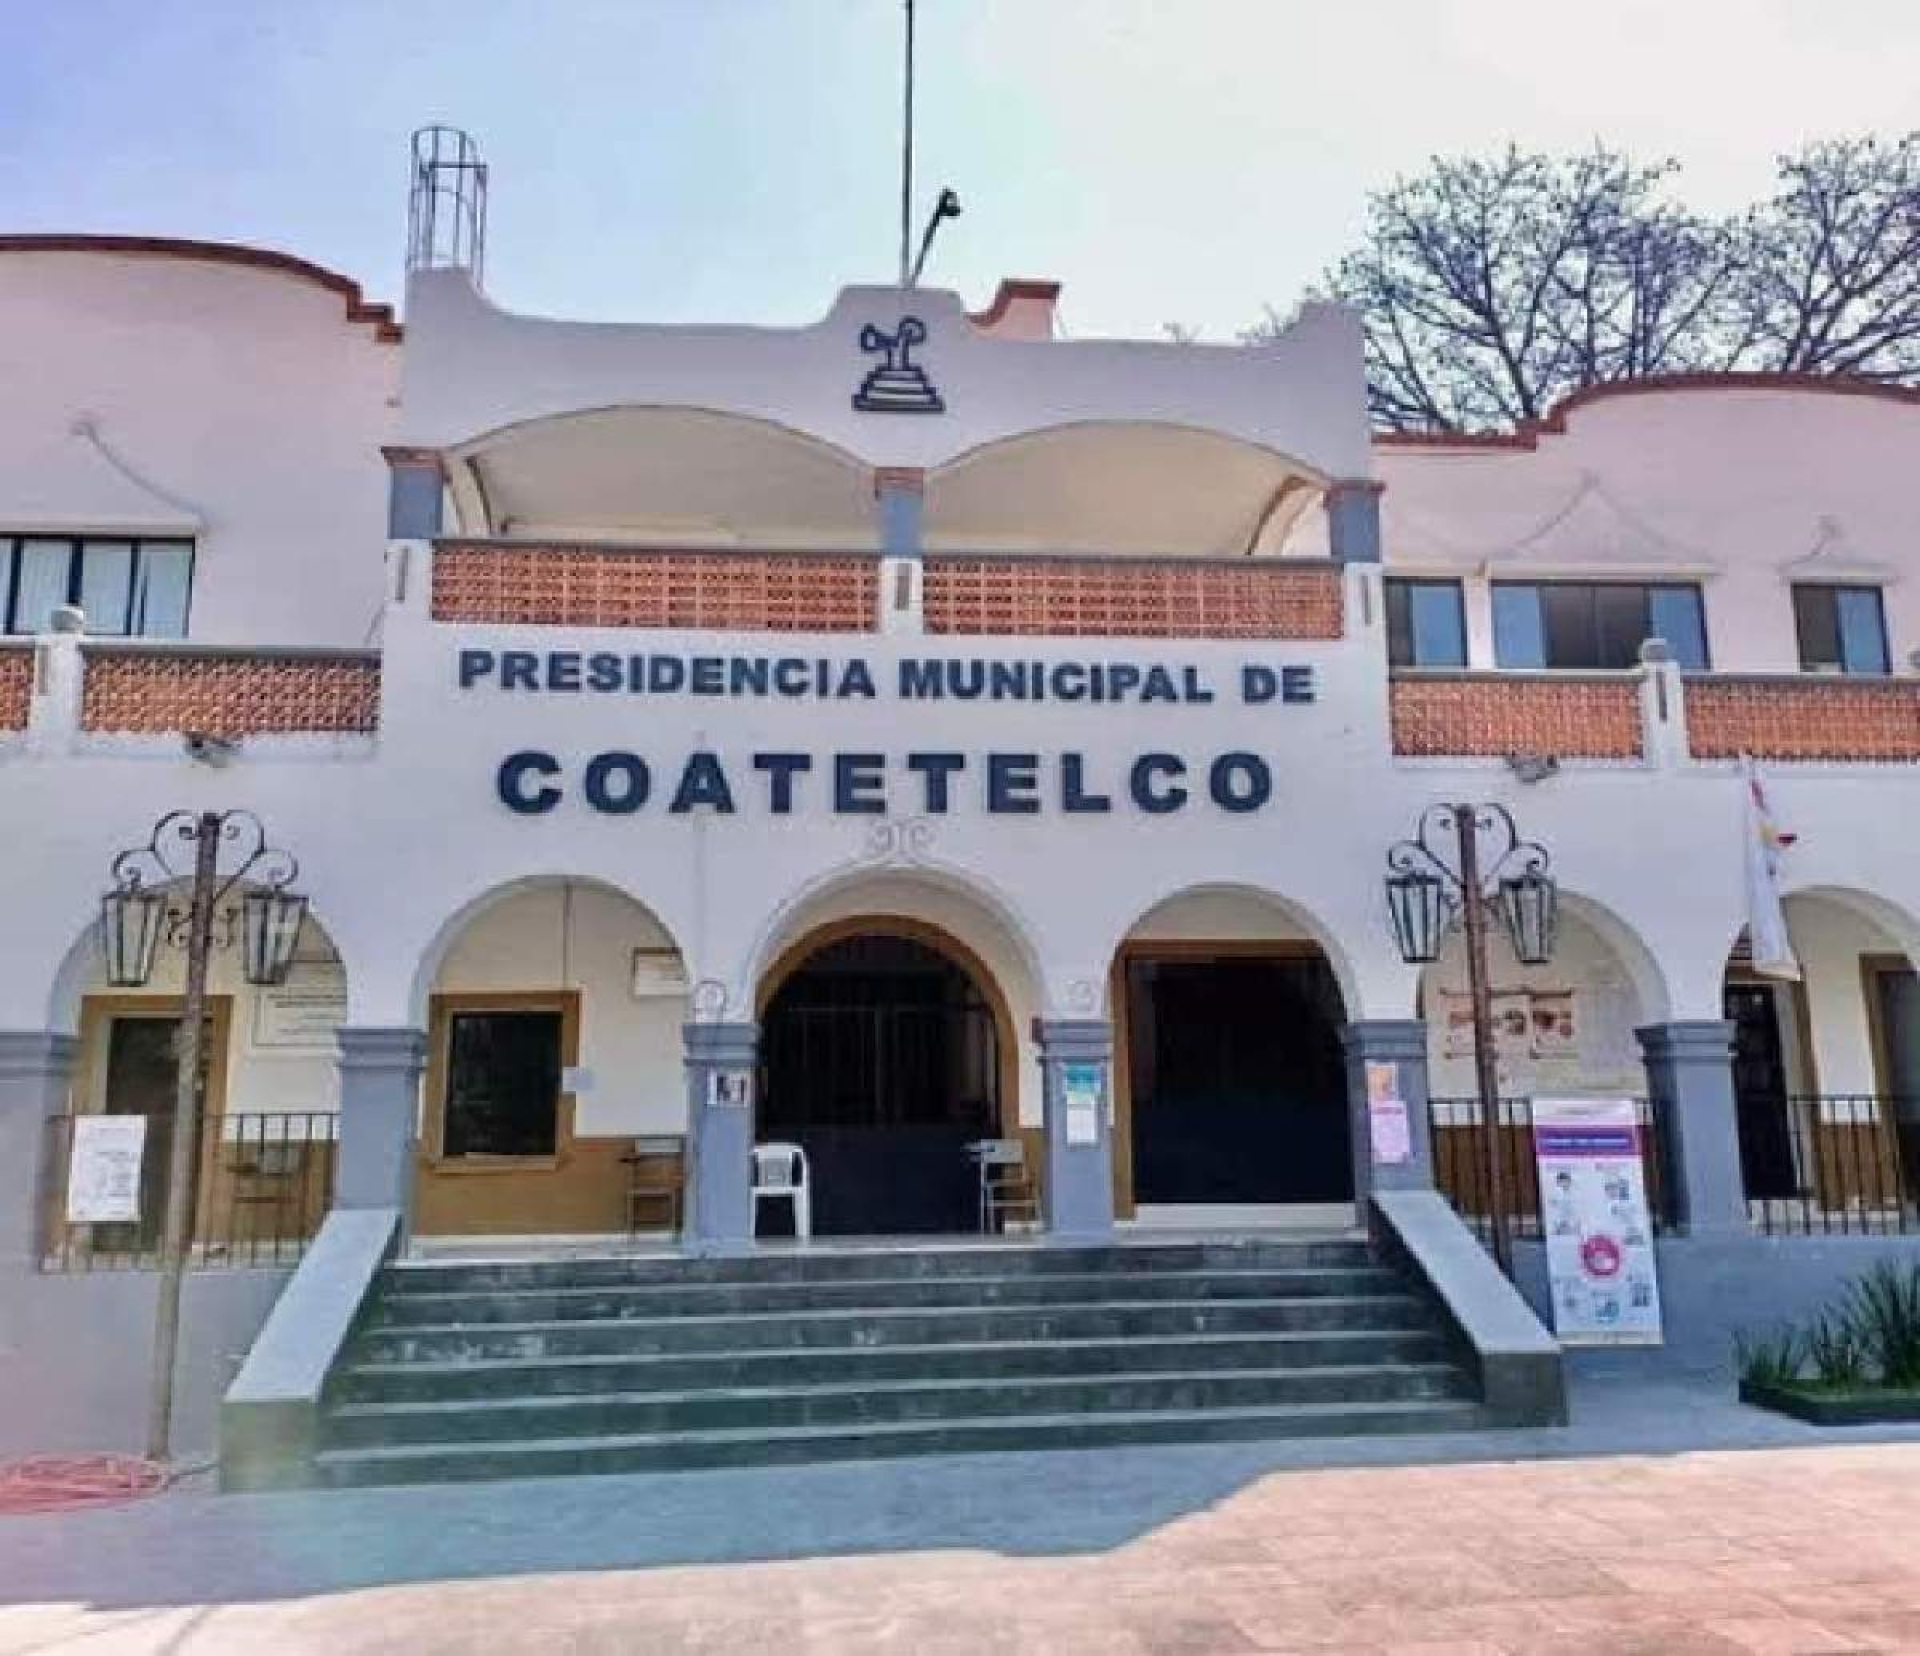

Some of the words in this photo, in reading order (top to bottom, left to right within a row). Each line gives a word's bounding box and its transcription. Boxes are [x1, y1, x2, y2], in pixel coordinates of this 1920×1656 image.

[459, 650, 876, 698] PRESIDENCIA
[899, 658, 1214, 703] MUNICIPAL
[1242, 665, 1315, 704] DE
[497, 750, 1273, 814] COATETELCO
